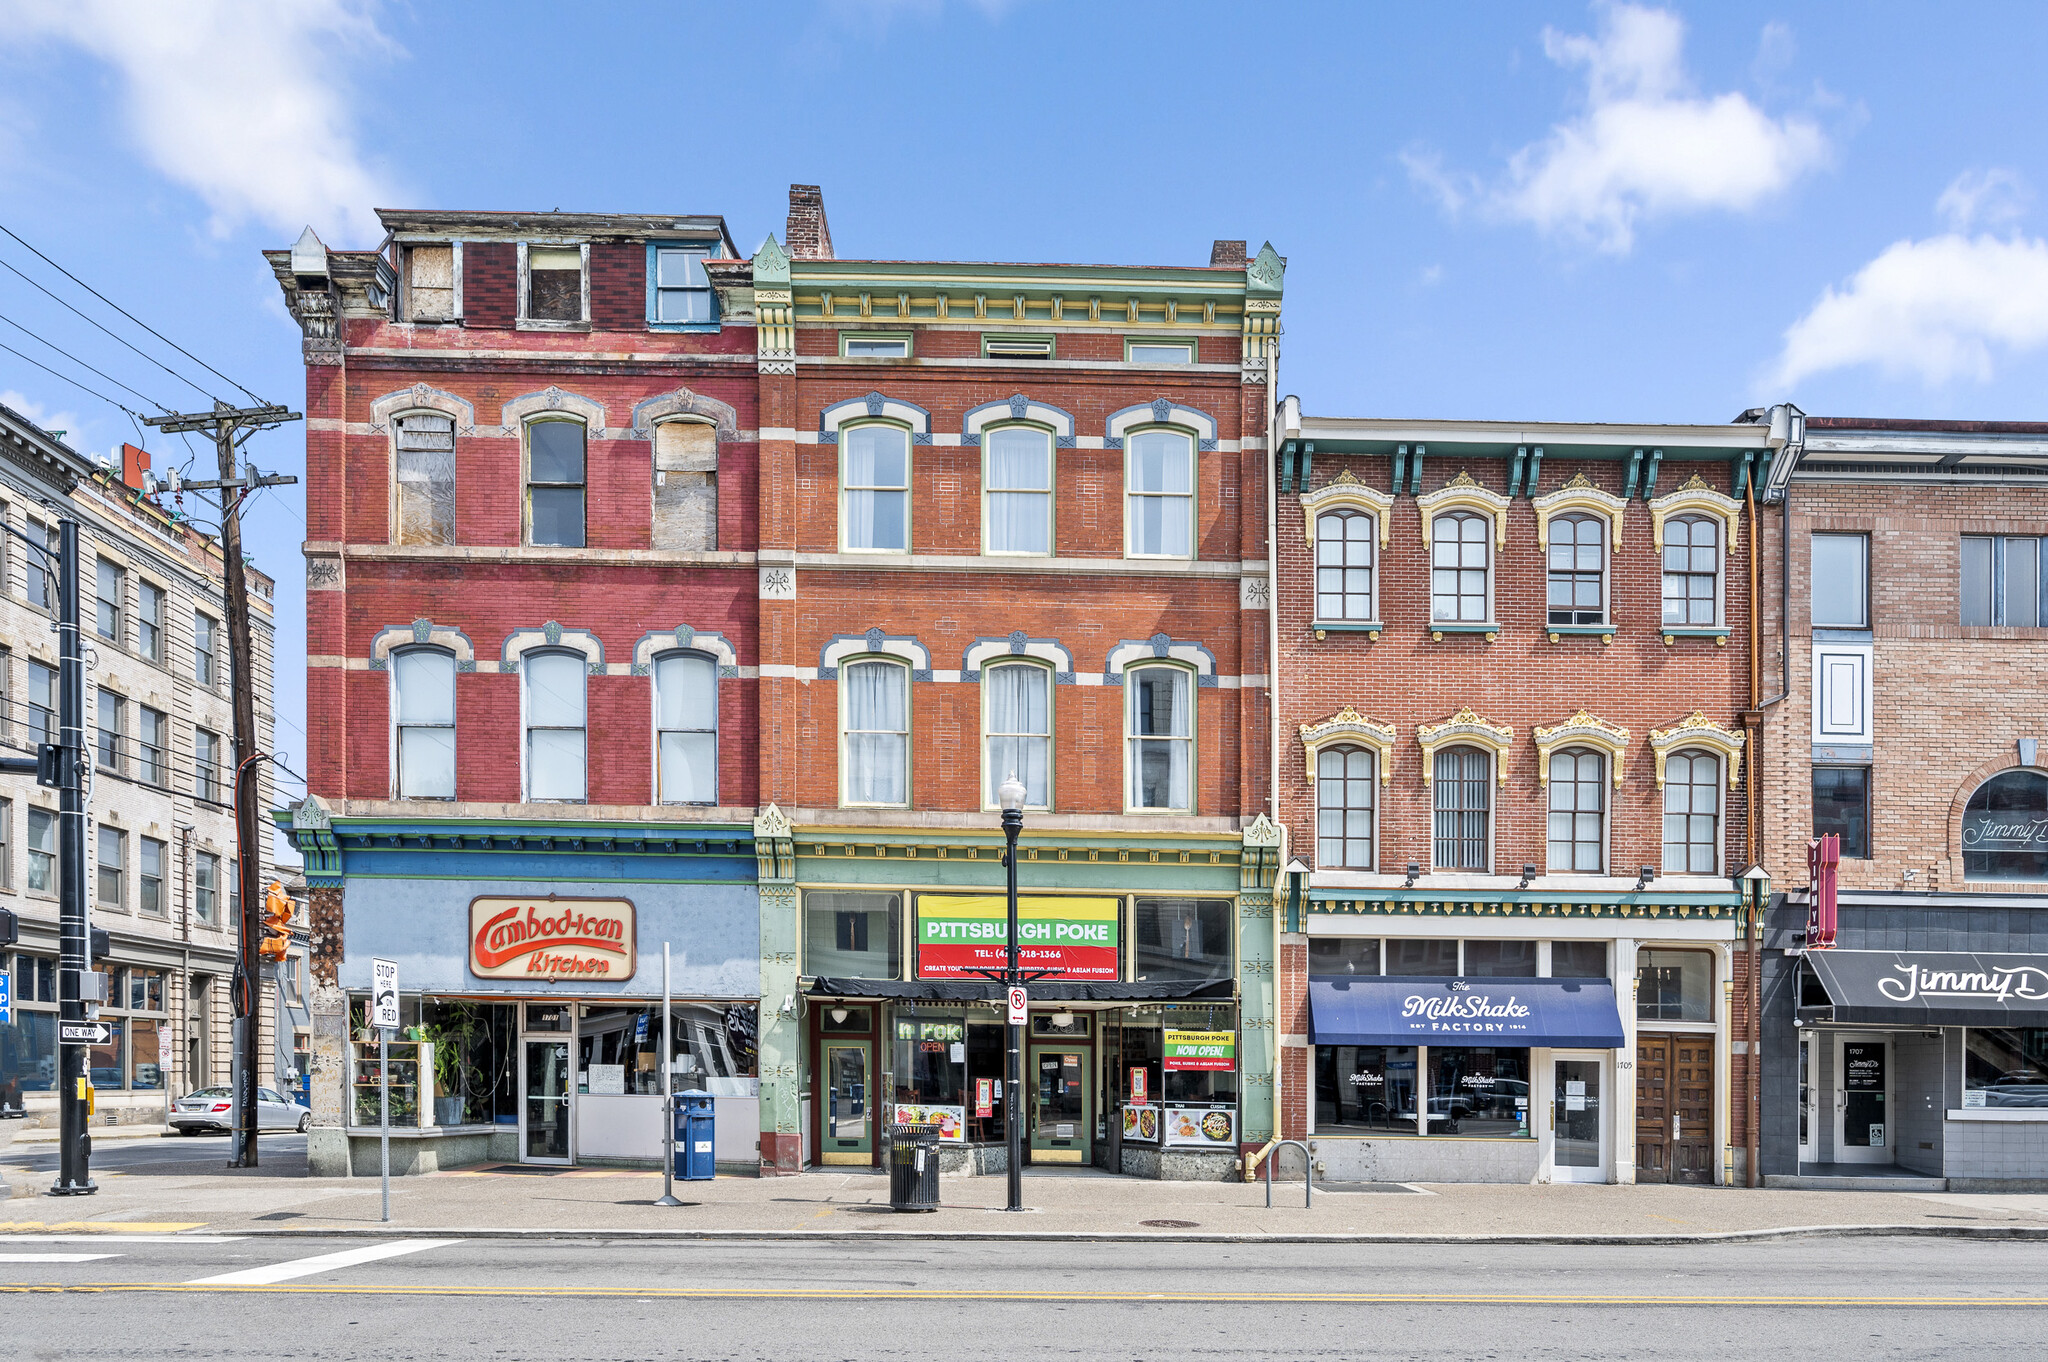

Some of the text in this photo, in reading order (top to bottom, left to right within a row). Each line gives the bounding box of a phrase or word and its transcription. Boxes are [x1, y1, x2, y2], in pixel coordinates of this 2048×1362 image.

[475, 907, 626, 968] Cambod-ican
[1056, 924, 1108, 940] POKE
[975, 950, 993, 958] TEL:
[1021, 950, 1061, 958] 918-1366
[527, 952, 609, 973] Kitchen
[376, 964, 395, 978] STOP
[380, 980, 392, 988] HERE
[1452, 981, 1470, 991] The
[1402, 995, 1530, 1020] MilkShake
[382, 1009, 397, 1021] RED
[65, 1028, 96, 1037] ONE WAY
[1432, 1023, 1504, 1031] FACTORY
[920, 1042, 945, 1052] OPEN
[1176, 1045, 1225, 1057] NOW OPEN!
